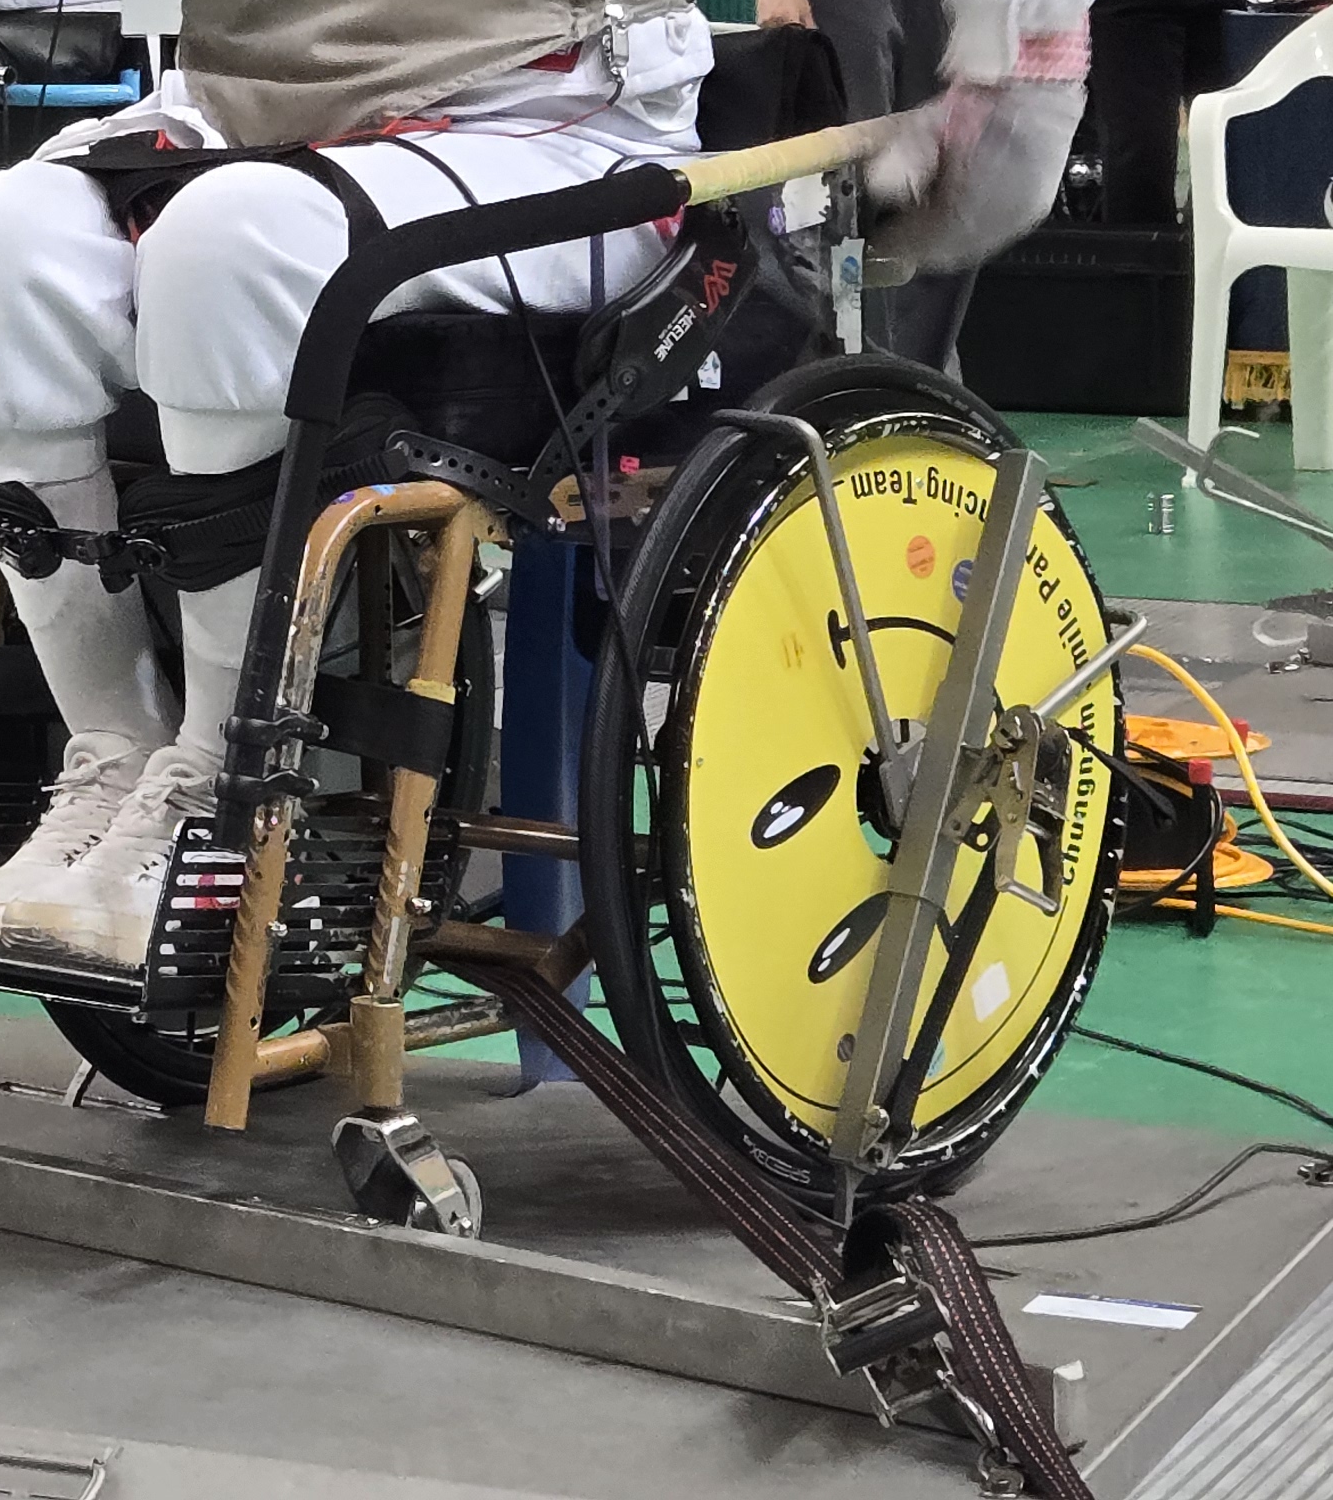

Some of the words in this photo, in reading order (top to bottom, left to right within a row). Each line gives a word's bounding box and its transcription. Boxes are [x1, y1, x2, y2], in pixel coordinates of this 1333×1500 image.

[851, 468, 919, 506] Team
[926, 467, 989, 524] ncing
[1025, 542, 1061, 604] Par
[1058, 599, 1093, 674] mile
